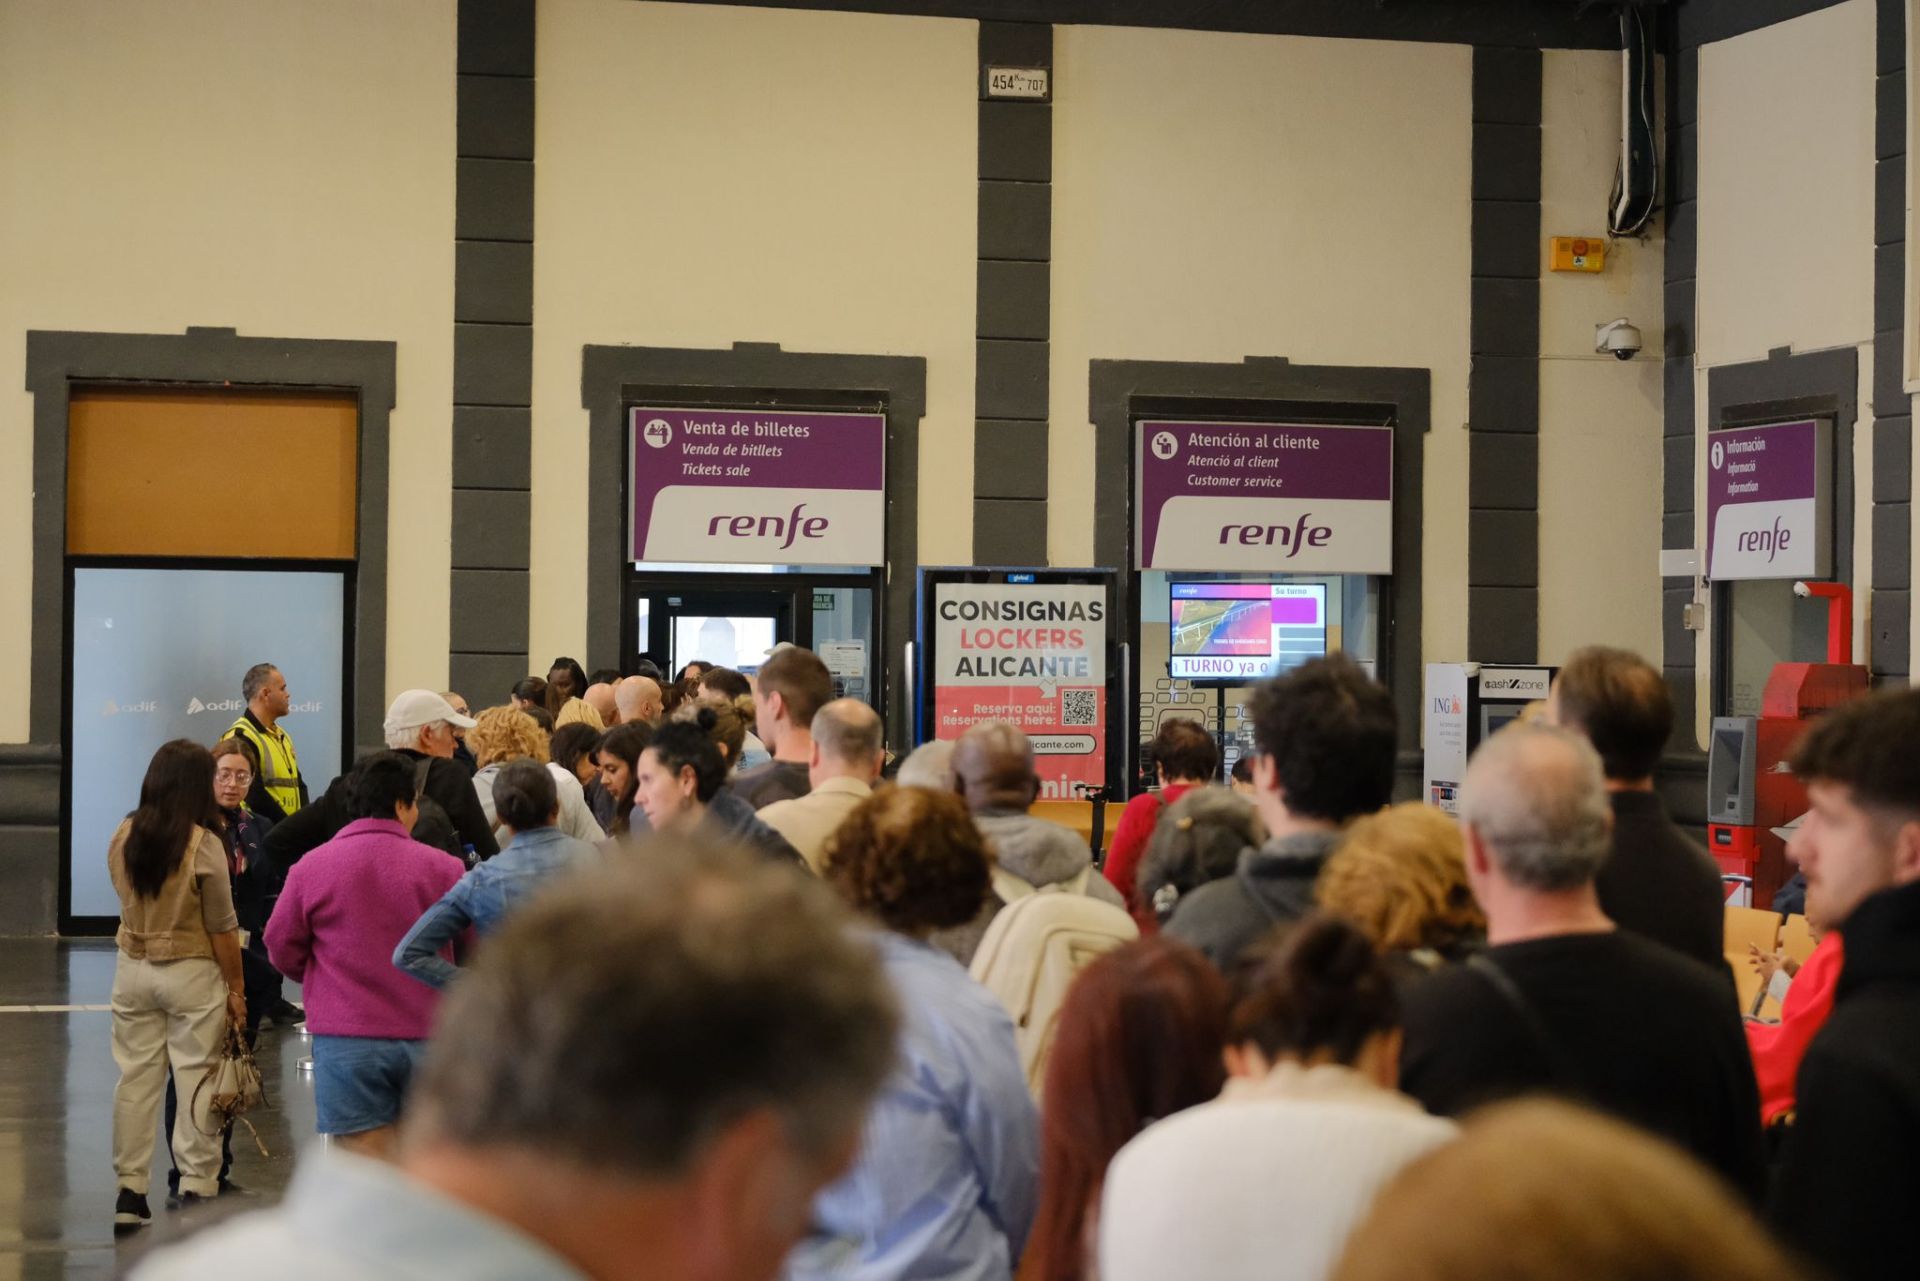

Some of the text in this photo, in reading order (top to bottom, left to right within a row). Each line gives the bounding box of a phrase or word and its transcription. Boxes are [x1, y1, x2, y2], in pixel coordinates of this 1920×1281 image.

[992, 75, 1014, 90] 454
[1027, 79, 1044, 91] 707
[683, 420, 810, 438] Venta de billetes
[1188, 432, 1320, 450] Atención al cliente
[1727, 436, 1766, 454] Información
[682, 443, 783, 457] Venda de bitllets
[1187, 454, 1279, 468] Atenció al client
[682, 463, 750, 477] Tickets sale
[1187, 474, 1282, 488] Customer service
[1728, 480, 1759, 496] Information
[708, 503, 829, 550] renfe
[1219, 512, 1332, 558] renfe
[1738, 515, 1791, 563] renfe
[1275, 587, 1307, 596] Su turno
[940, 600, 1103, 622] CONSIGNAS
[961, 628, 1084, 650] LOCKERS
[955, 656, 1088, 677] ALICANTE
[1183, 659, 1234, 673] TURNO
[1239, 662, 1254, 676] ya
[121, 701, 157, 712] adif
[207, 699, 243, 711] adif
[289, 701, 323, 713] adif
[974, 703, 1022, 714] Reserva
[1434, 697, 1450, 714] ING
[1025, 714, 1056, 725] here:
